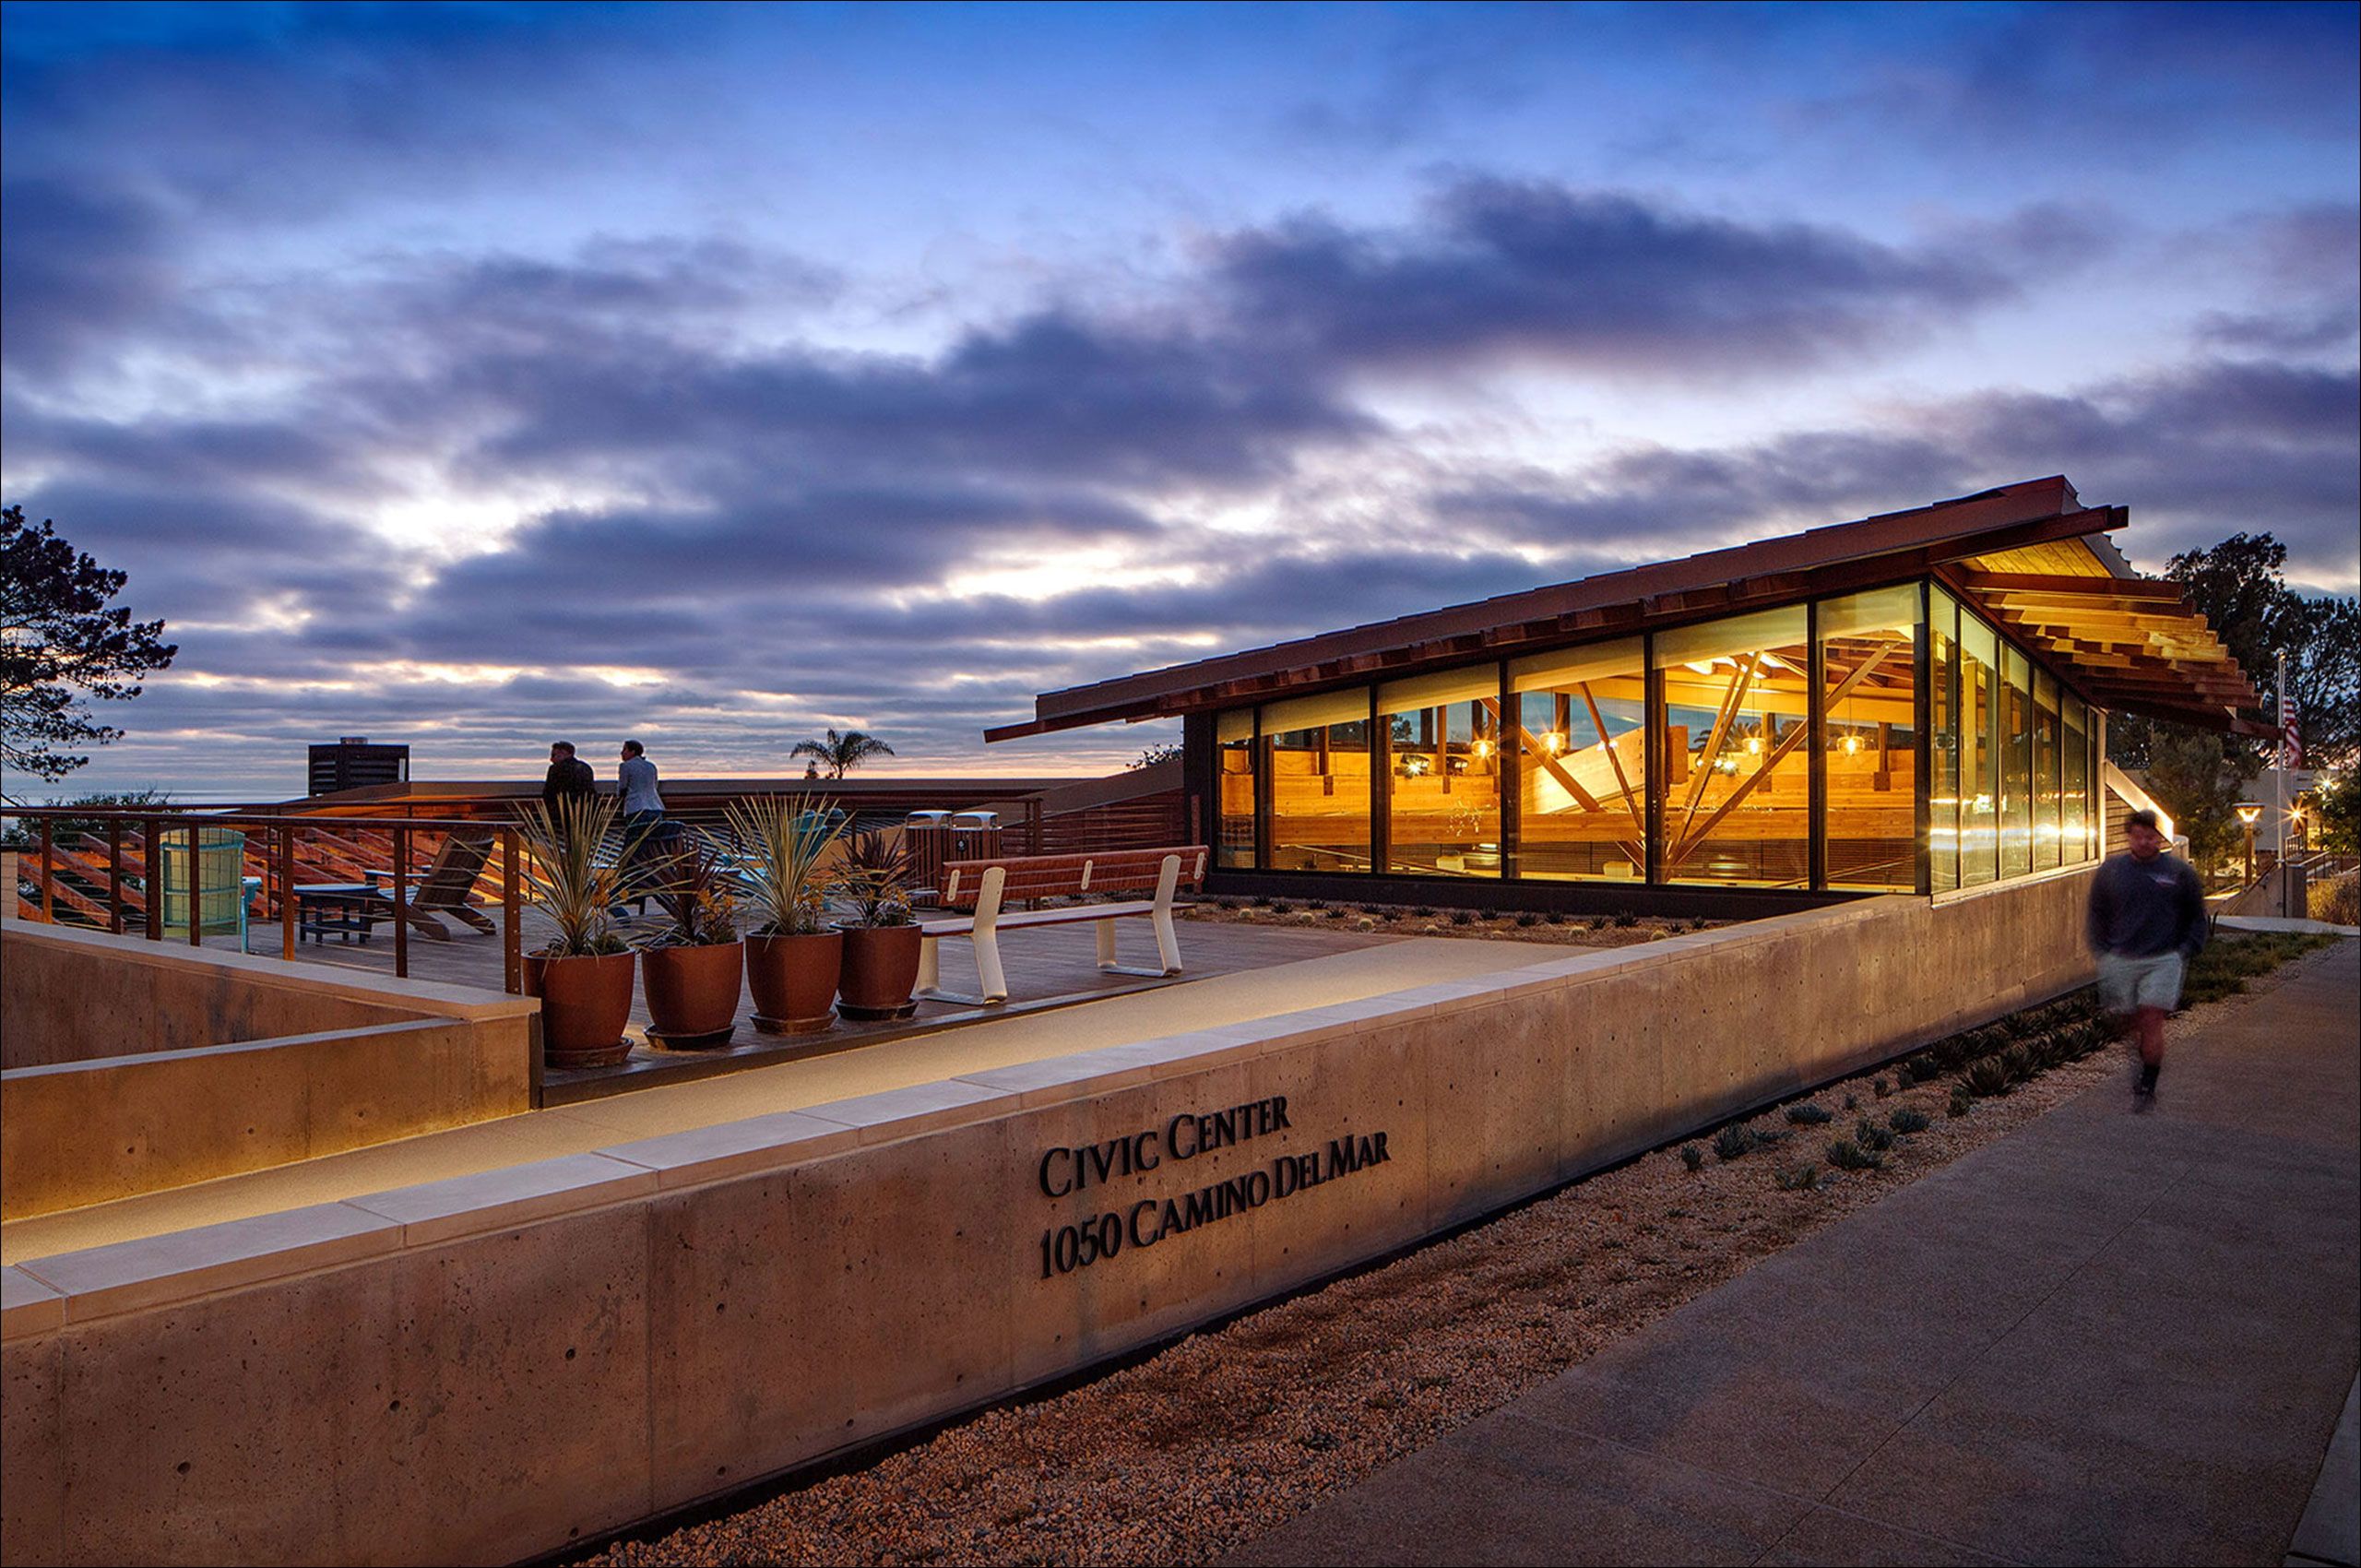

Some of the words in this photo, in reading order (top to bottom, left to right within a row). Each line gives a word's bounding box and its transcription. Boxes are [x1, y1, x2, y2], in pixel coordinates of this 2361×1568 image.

[1038, 1131, 1160, 1198] CIVIC
[1167, 1096, 1291, 1160] CENTER
[1039, 1212, 1122, 1280] 1050
[1129, 1170, 1270, 1248] CAMINO
